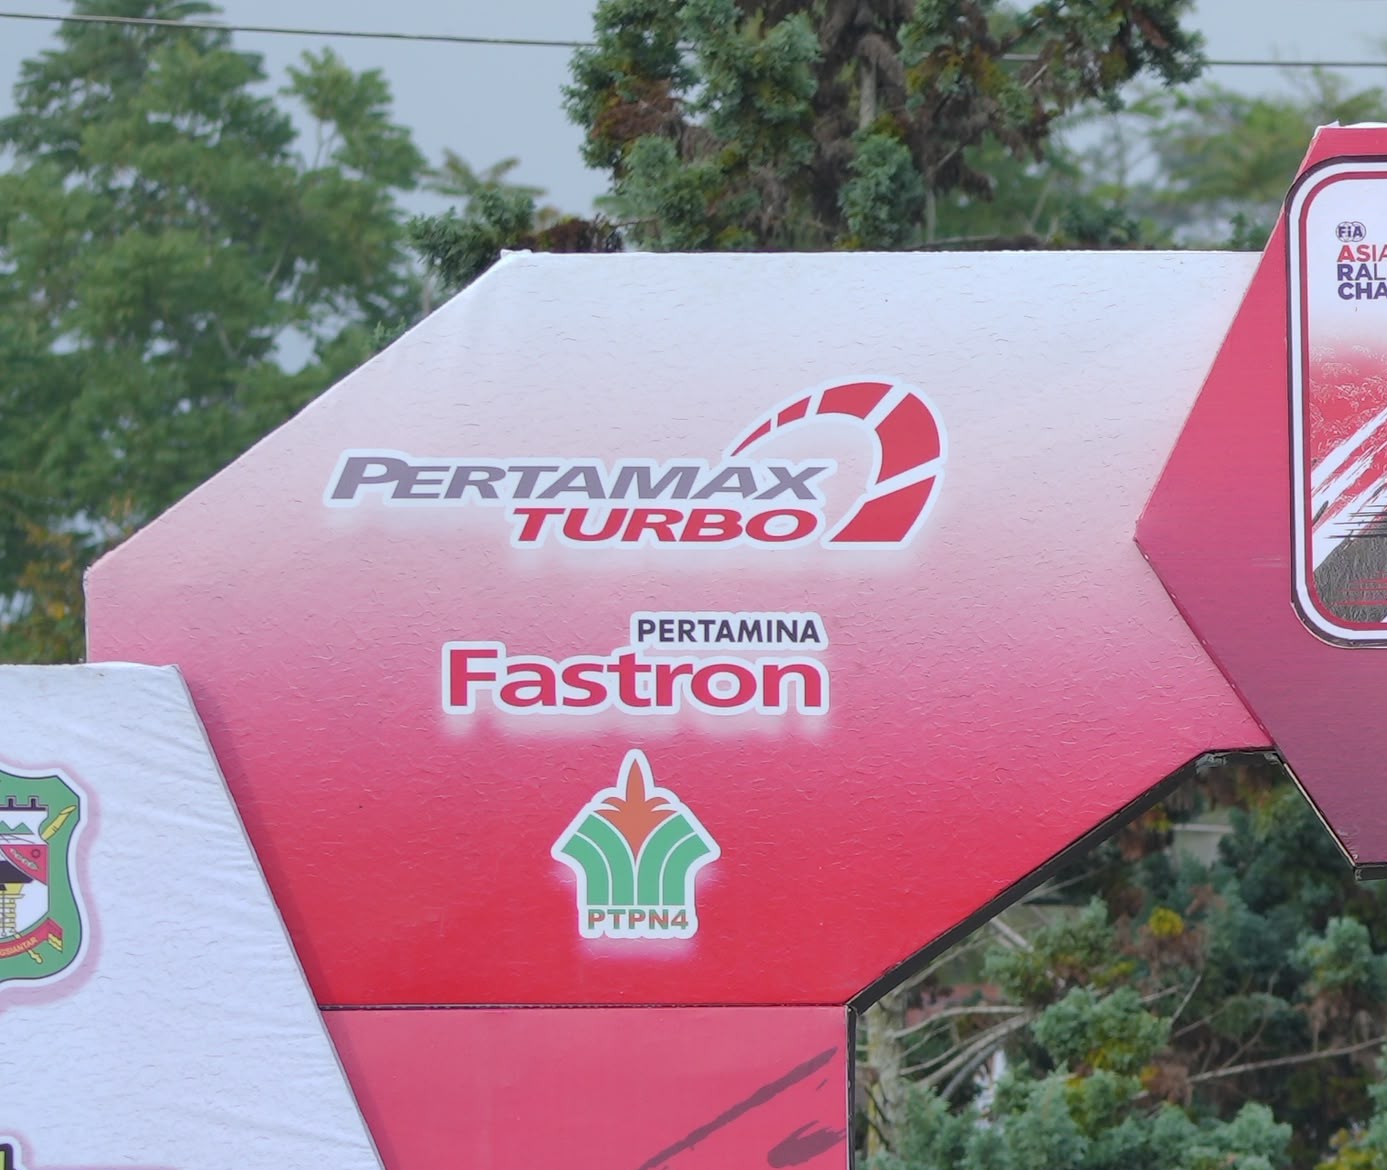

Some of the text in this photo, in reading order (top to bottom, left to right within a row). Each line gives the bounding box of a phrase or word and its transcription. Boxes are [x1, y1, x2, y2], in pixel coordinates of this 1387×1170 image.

[330, 456, 830, 501] PERTAMAX
[511, 506, 818, 543] TURBO
[637, 617, 822, 644] PERTAMINA
[448, 647, 823, 709] Fastron
[586, 907, 689, 931] PTPN4
